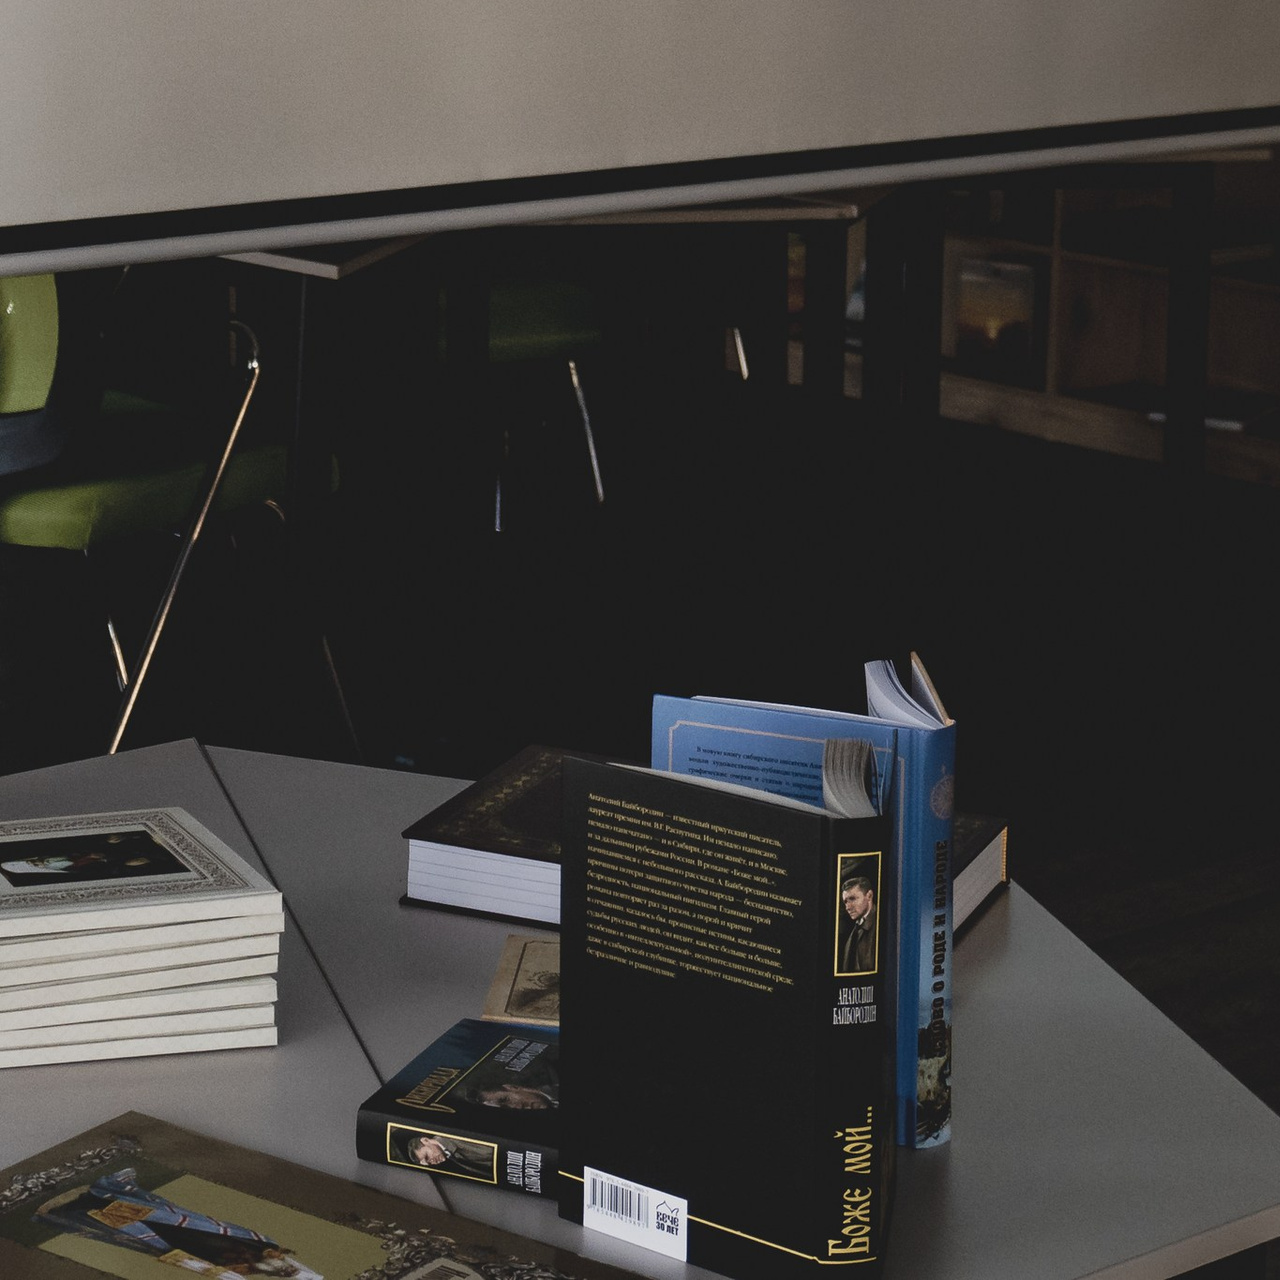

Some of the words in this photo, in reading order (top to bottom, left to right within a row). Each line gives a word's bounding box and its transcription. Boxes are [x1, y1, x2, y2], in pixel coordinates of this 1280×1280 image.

[710, 825, 748, 838] иркутский
[931, 931, 948, 977] РОДЕ
[837, 985, 874, 1006] АНАТОЛИЙ
[932, 981, 947, 993] О
[832, 1005, 877, 1026] БАЙБОРОДИН
[655, 1221, 666, 1232] 30
[665, 1223, 680, 1236] ЛЕТ
